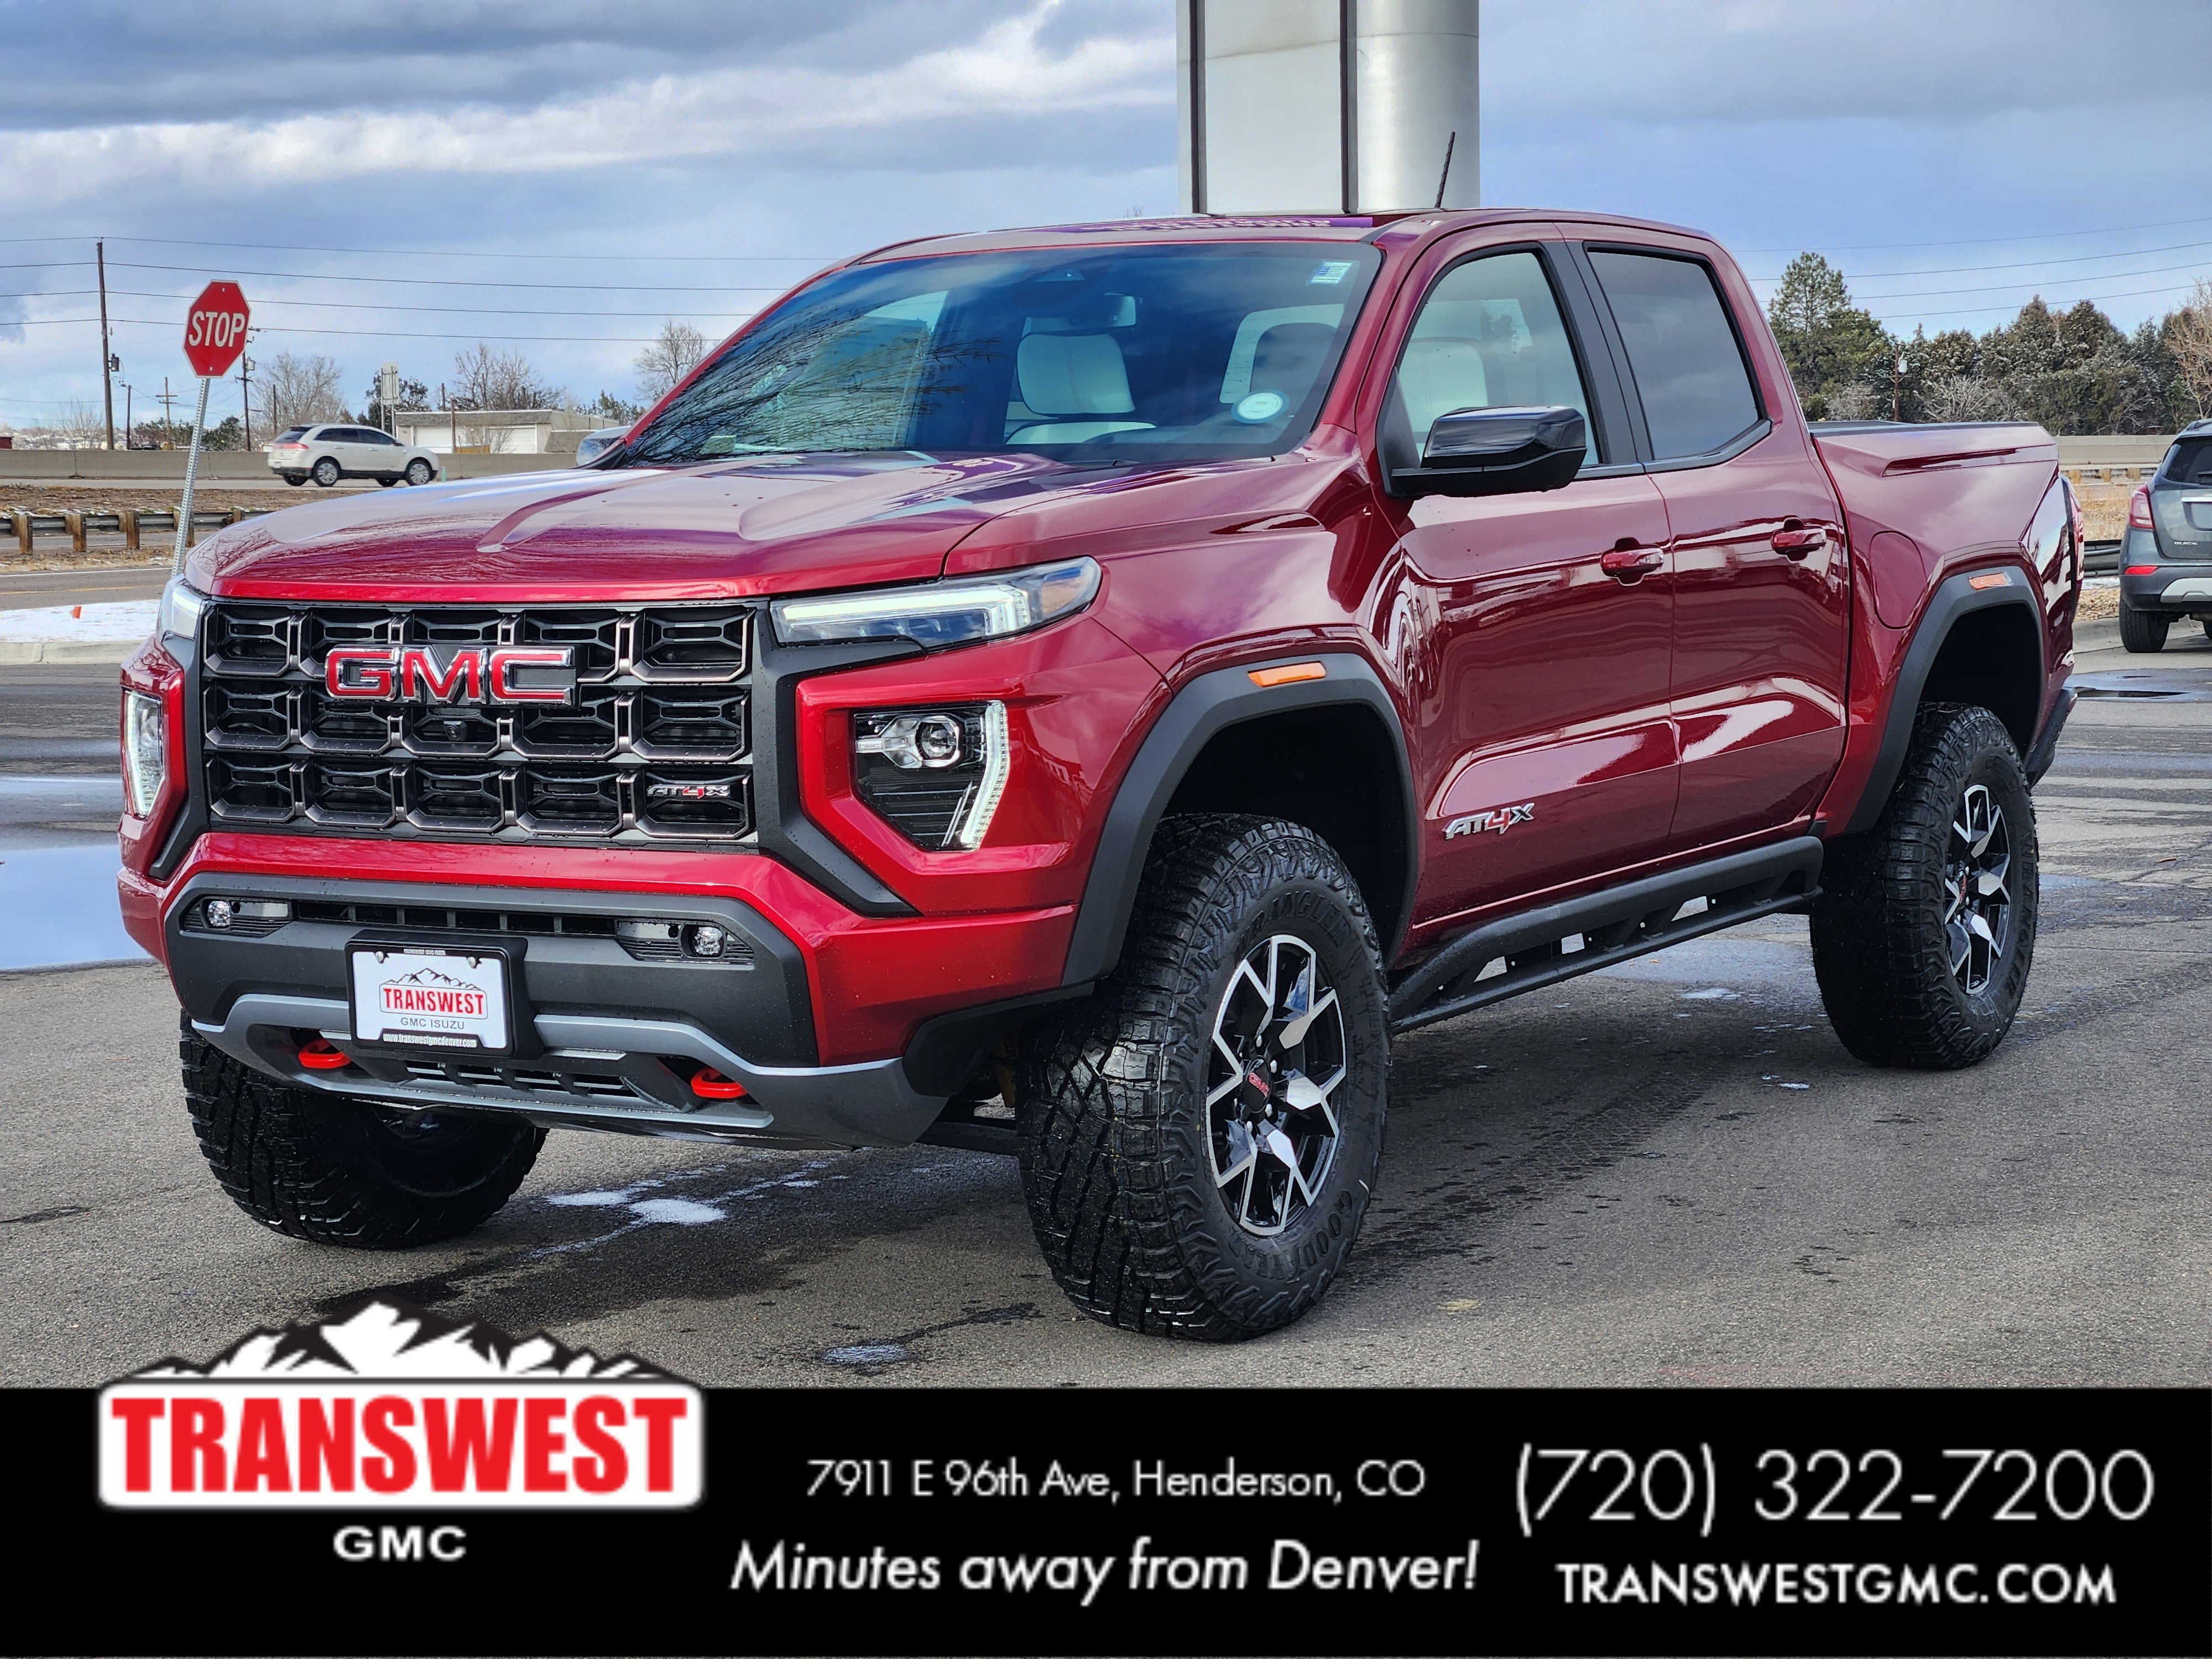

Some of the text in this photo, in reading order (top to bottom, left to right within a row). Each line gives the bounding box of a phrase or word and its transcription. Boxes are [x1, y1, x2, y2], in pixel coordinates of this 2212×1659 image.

[189, 311, 246, 347] STOP
[325, 647, 572, 705] GMC
[646, 784, 729, 799] AT4X
[1442, 803, 1535, 839] AT4X
[384, 988, 484, 1015] TRANSWEST
[400, 1017, 465, 1030] GMC ISUZU
[383, 1033, 477, 1048] www.transwestgmcdenver.com
